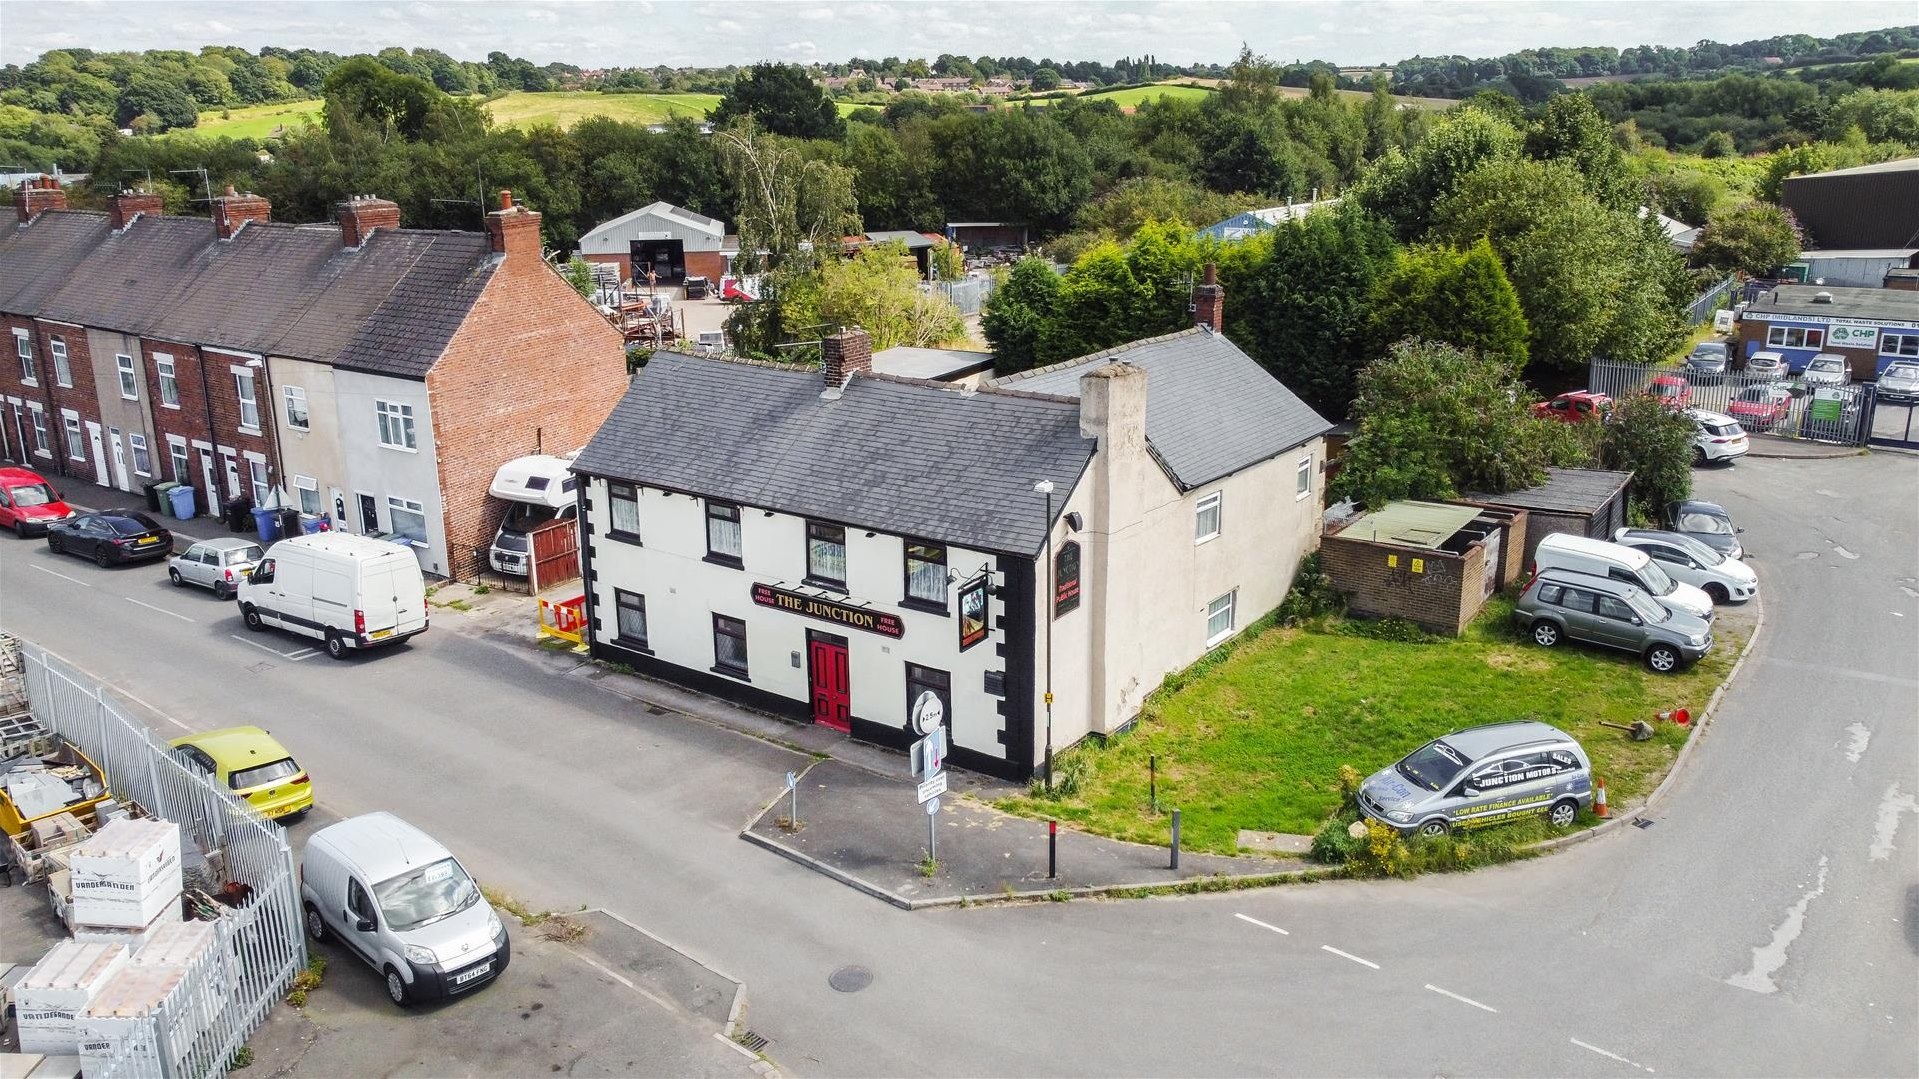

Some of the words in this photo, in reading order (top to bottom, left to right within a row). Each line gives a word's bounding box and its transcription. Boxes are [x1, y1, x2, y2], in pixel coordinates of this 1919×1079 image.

[1852, 329, 1876, 338] CHP
[758, 587, 771, 596] FREE
[755, 594, 775, 605] HOUSE
[776, 593, 802, 610] THE
[805, 601, 874, 627] JUNCTION
[880, 616, 895, 625] FREE
[876, 623, 900, 635] HOUSE
[1552, 752, 1572, 764] SALES
[1480, 774, 1525, 788] JUNCTION
[1525, 767, 1557, 781] MOTORS
[1471, 804, 1488, 813] RATE
[1489, 800, 1517, 810] FINANCE
